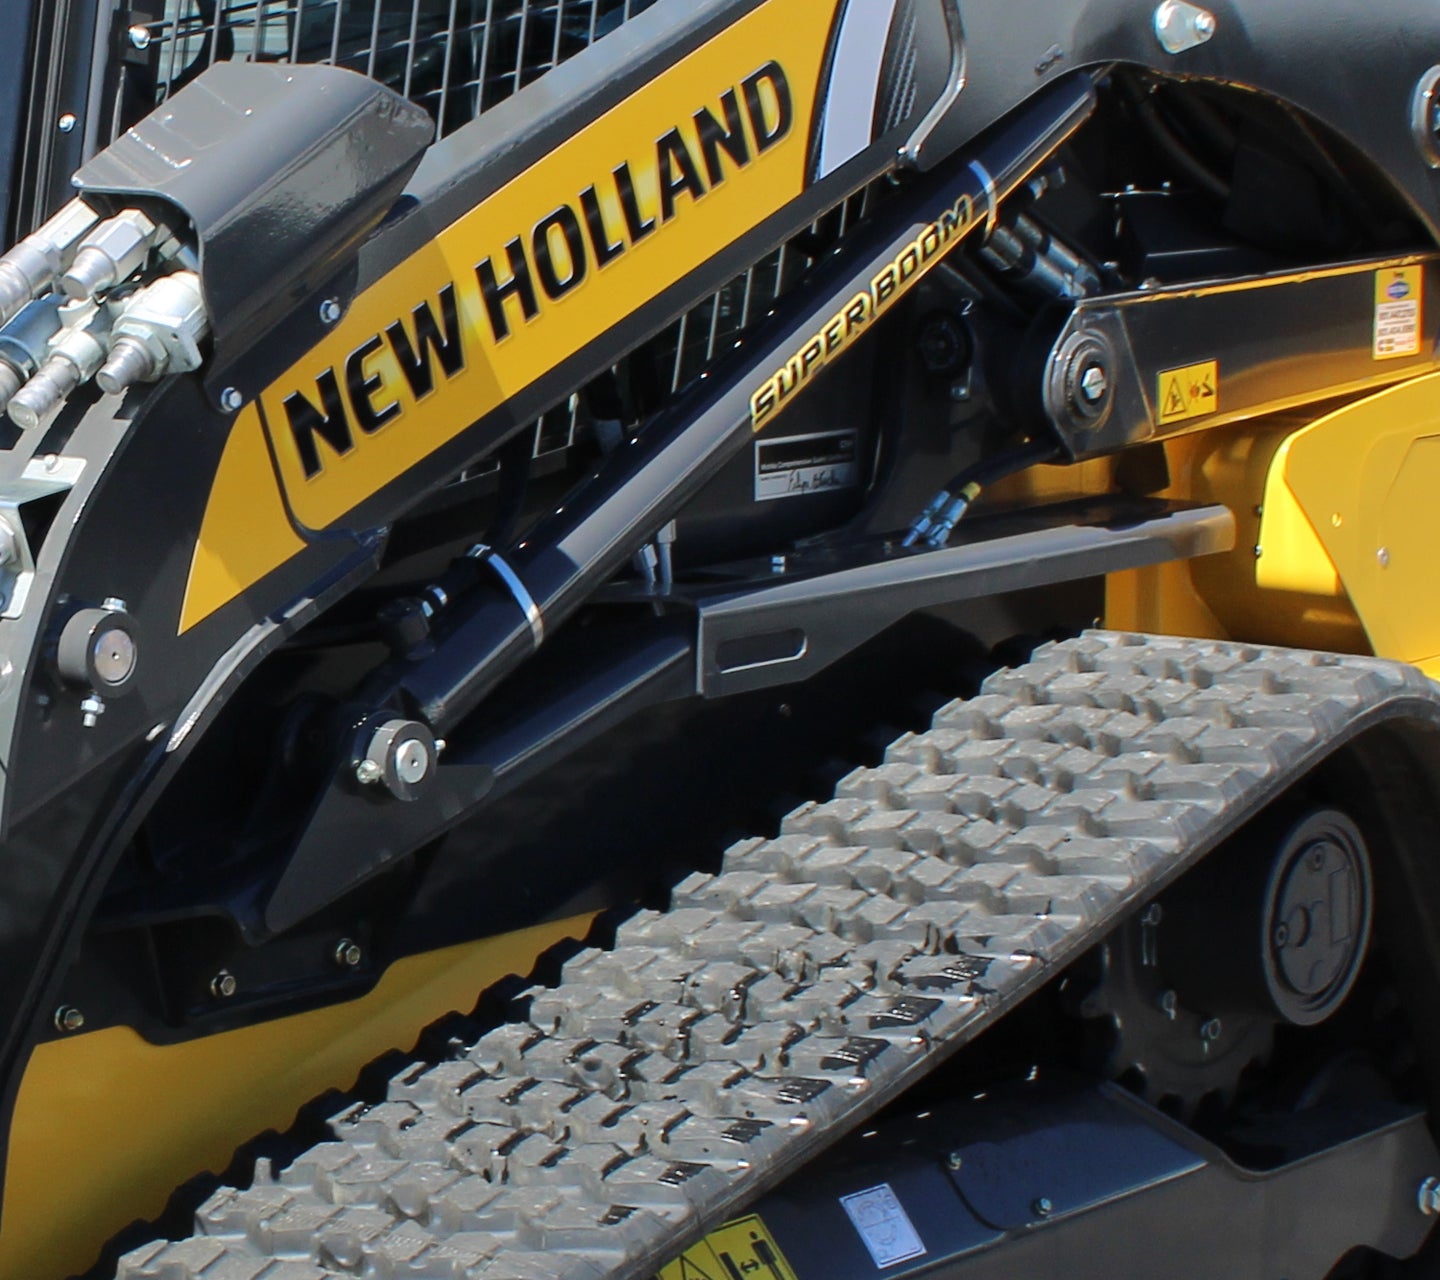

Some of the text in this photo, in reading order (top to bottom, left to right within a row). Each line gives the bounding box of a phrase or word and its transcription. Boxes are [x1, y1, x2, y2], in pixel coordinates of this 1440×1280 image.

[282, 58, 794, 483] NEW HOLLAND
[750, 193, 974, 426] SUPER BOOM
